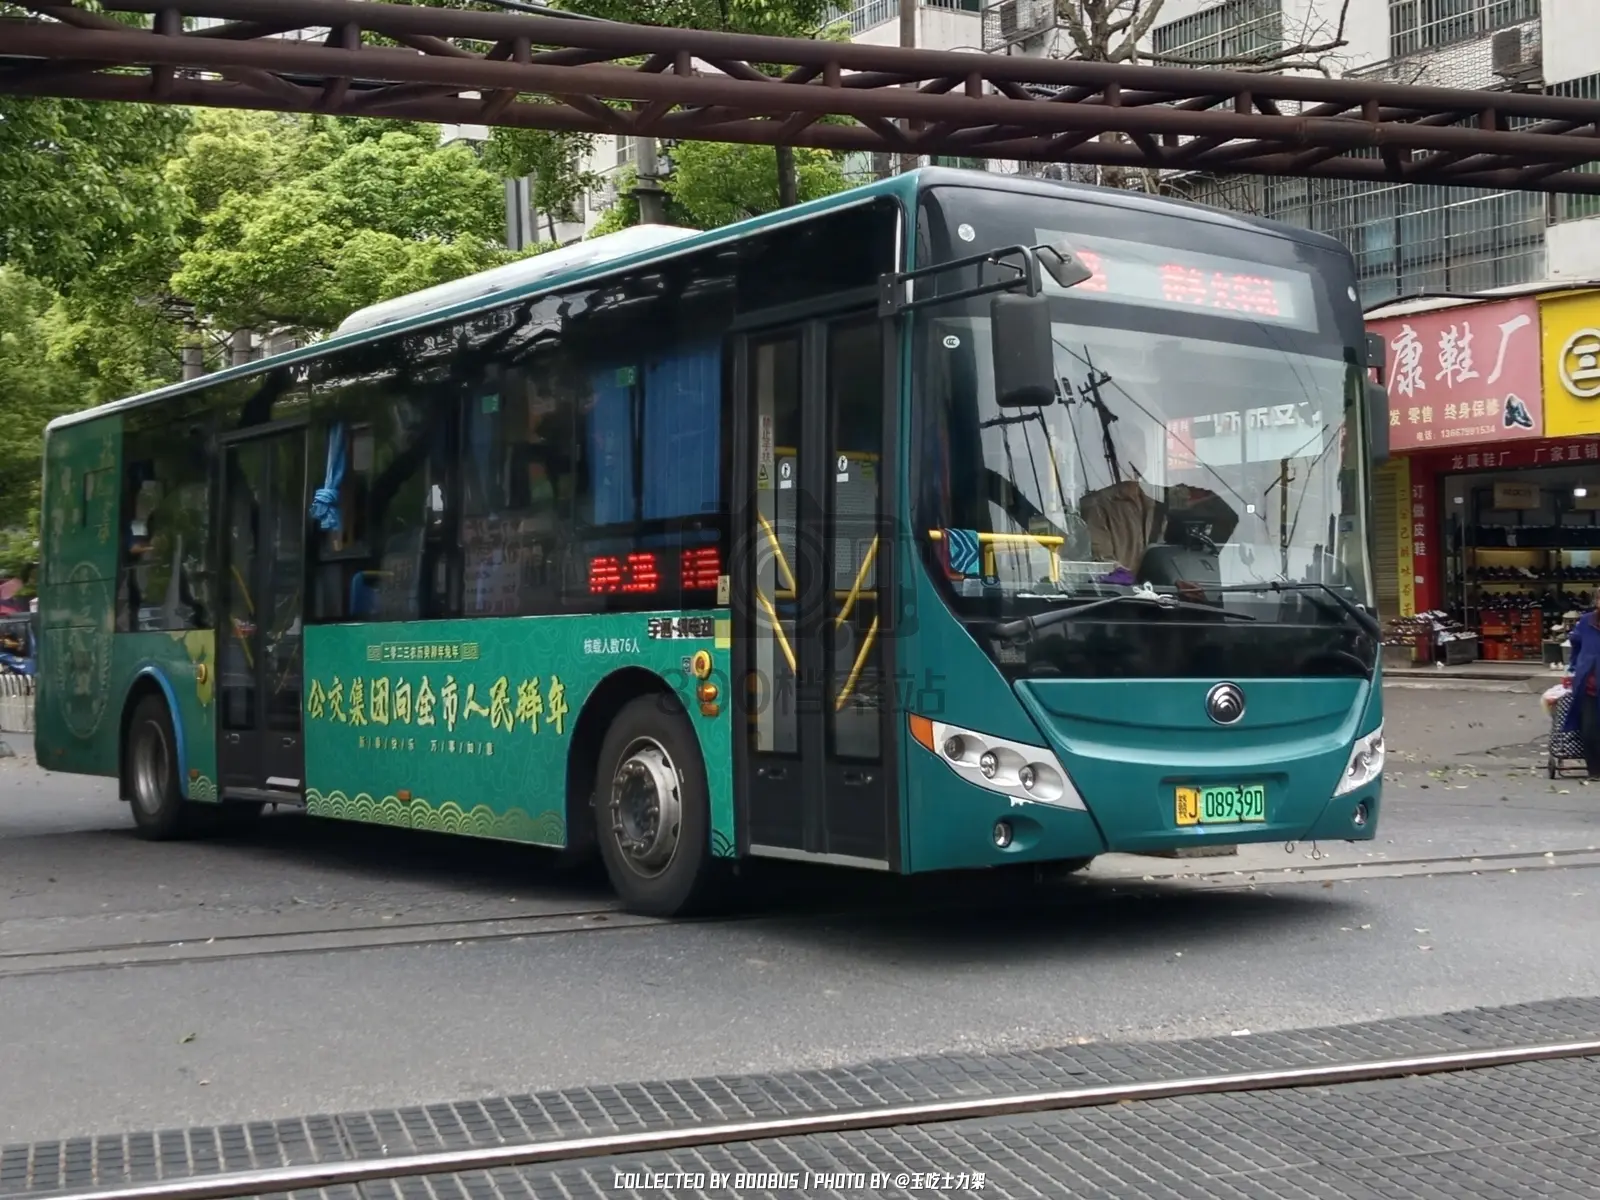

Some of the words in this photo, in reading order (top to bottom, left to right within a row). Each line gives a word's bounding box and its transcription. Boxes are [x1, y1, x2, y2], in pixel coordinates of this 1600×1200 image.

[1367, 314, 1531, 398] 康鞋厂
[1408, 406, 1433, 424] 零售
